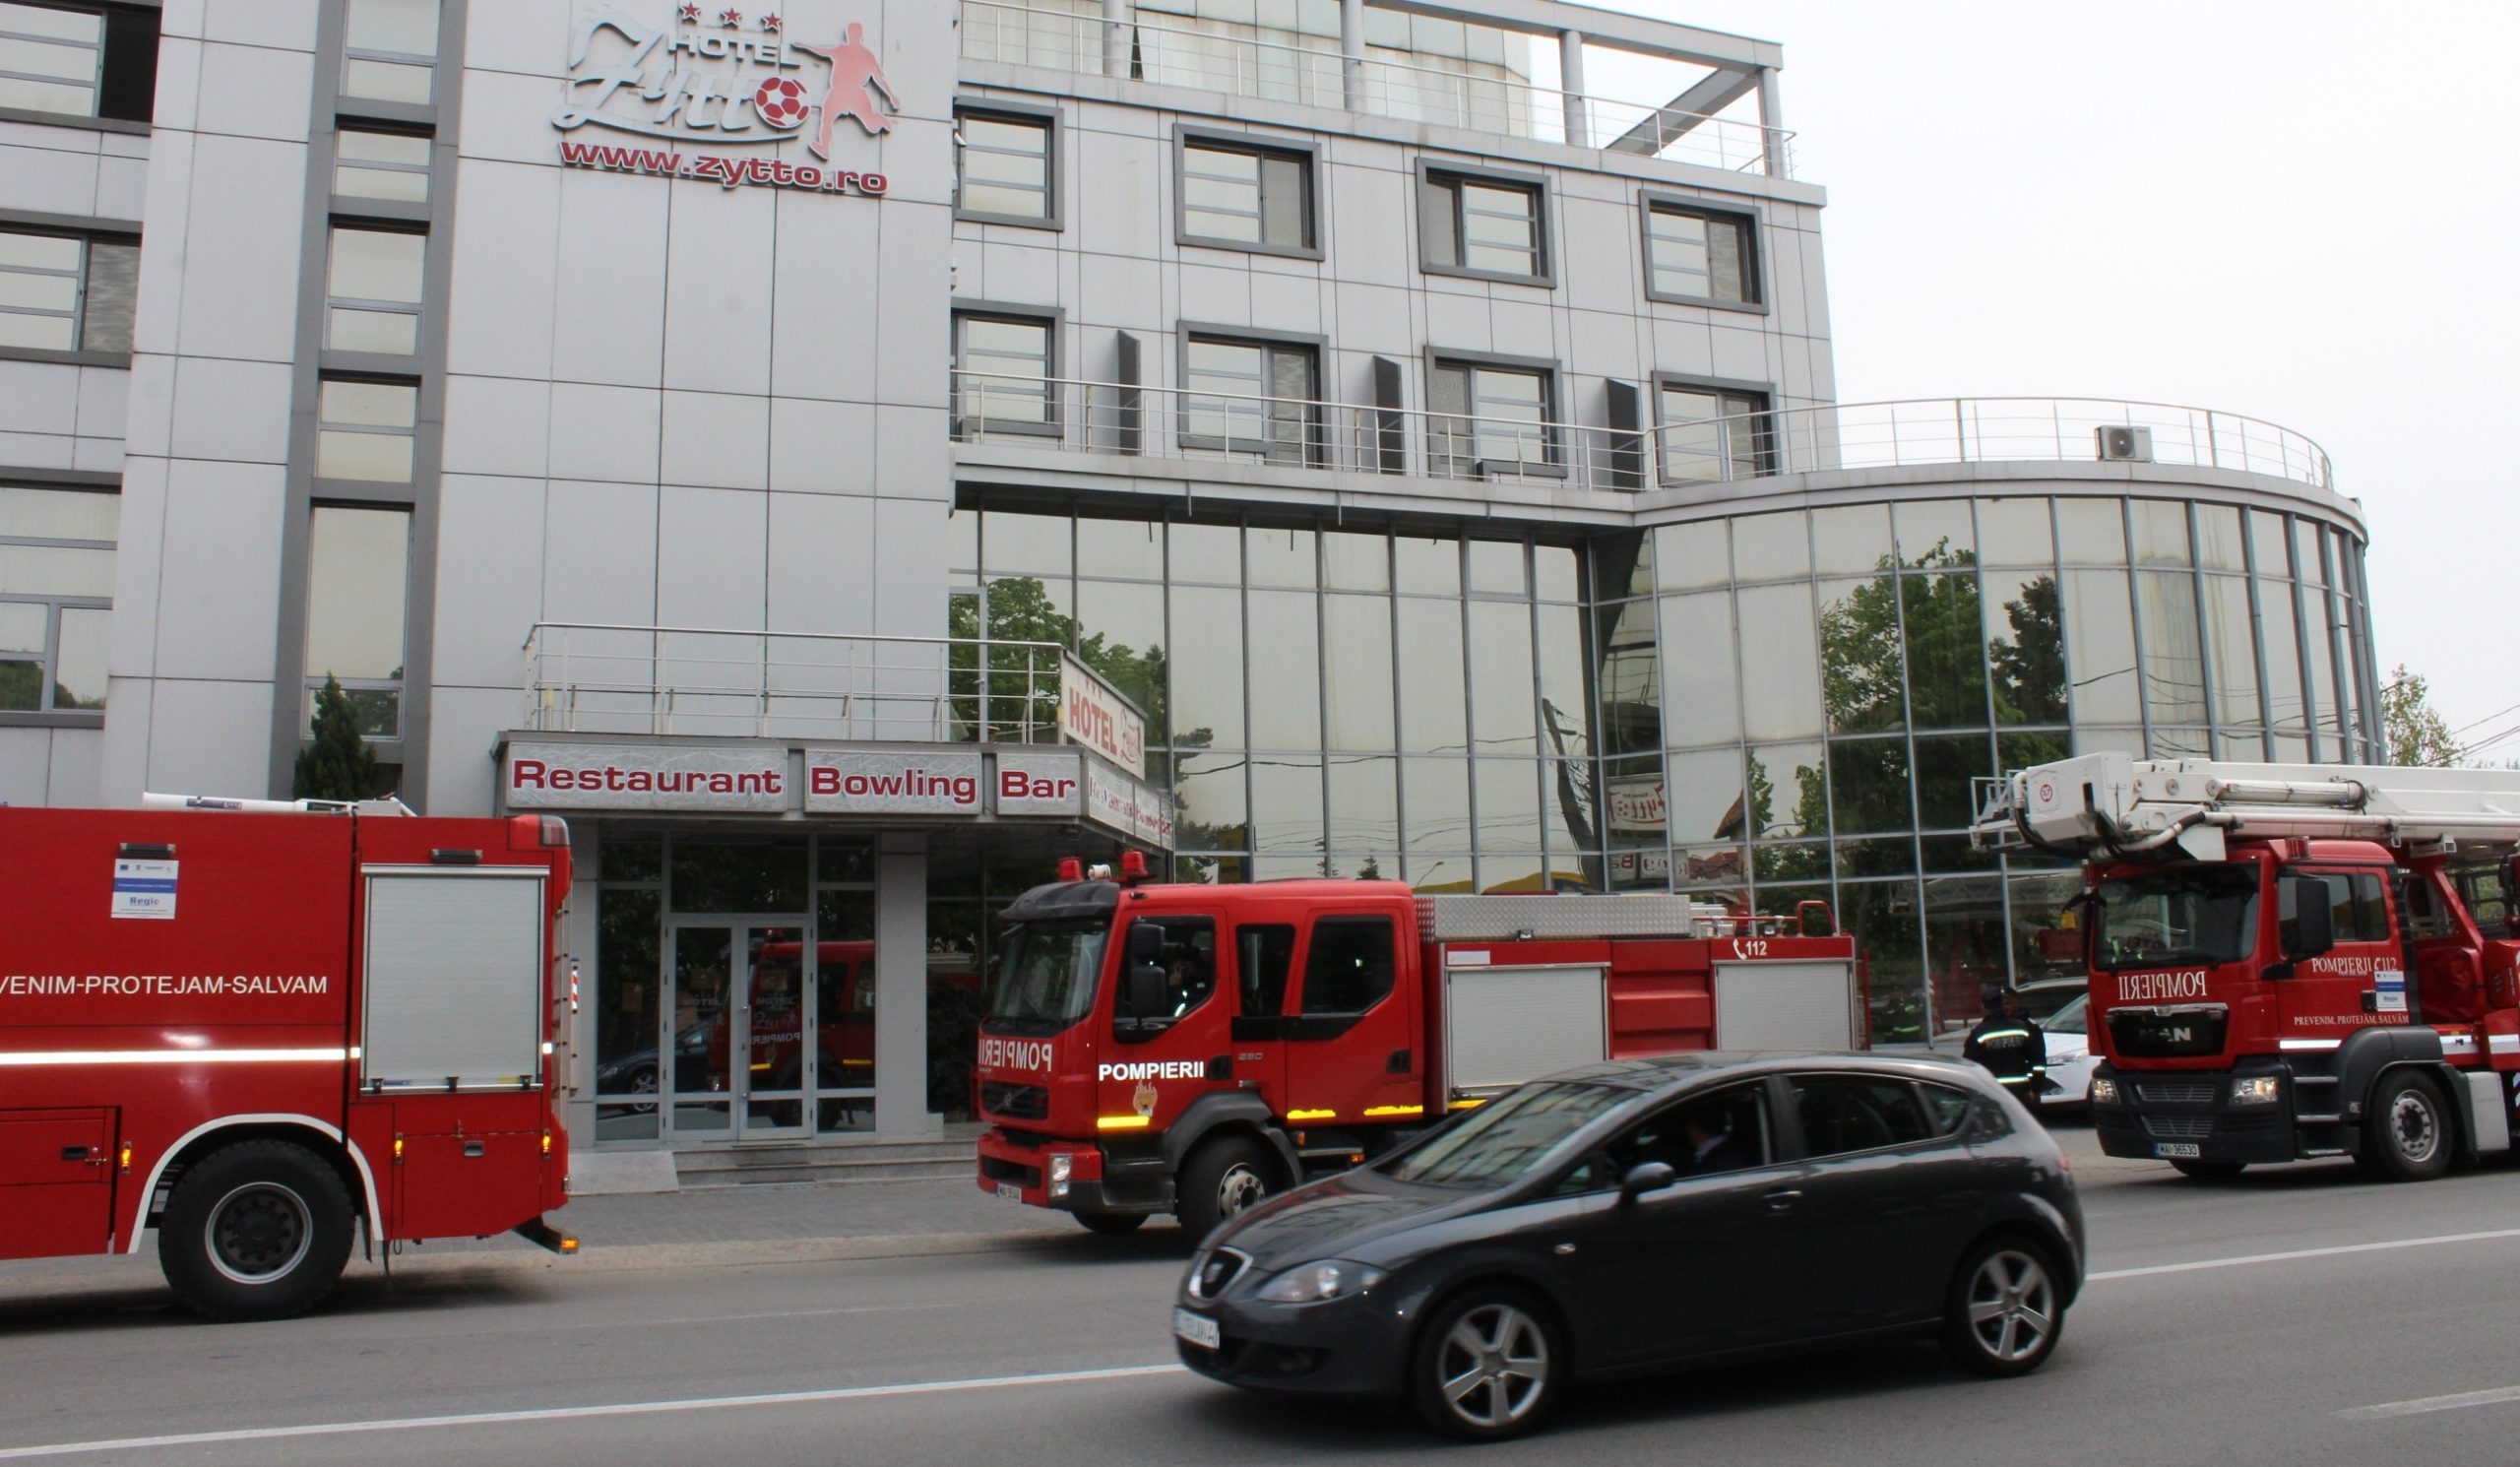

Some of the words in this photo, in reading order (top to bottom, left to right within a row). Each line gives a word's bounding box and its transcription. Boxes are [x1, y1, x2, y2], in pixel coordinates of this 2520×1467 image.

[667, 32, 800, 69] HOTEL
[559, 141, 888, 195] www.zytto.ro
[1069, 686, 1117, 757] HOTEL
[512, 759, 783, 795] Restaurant
[810, 767, 977, 805] Bowling
[1000, 771, 1077, 799] Bar
[1745, 940, 1768, 956] 112
[2311, 957, 2372, 973] POMPIERII
[1099, 1060, 1205, 1082] POMPIERII
